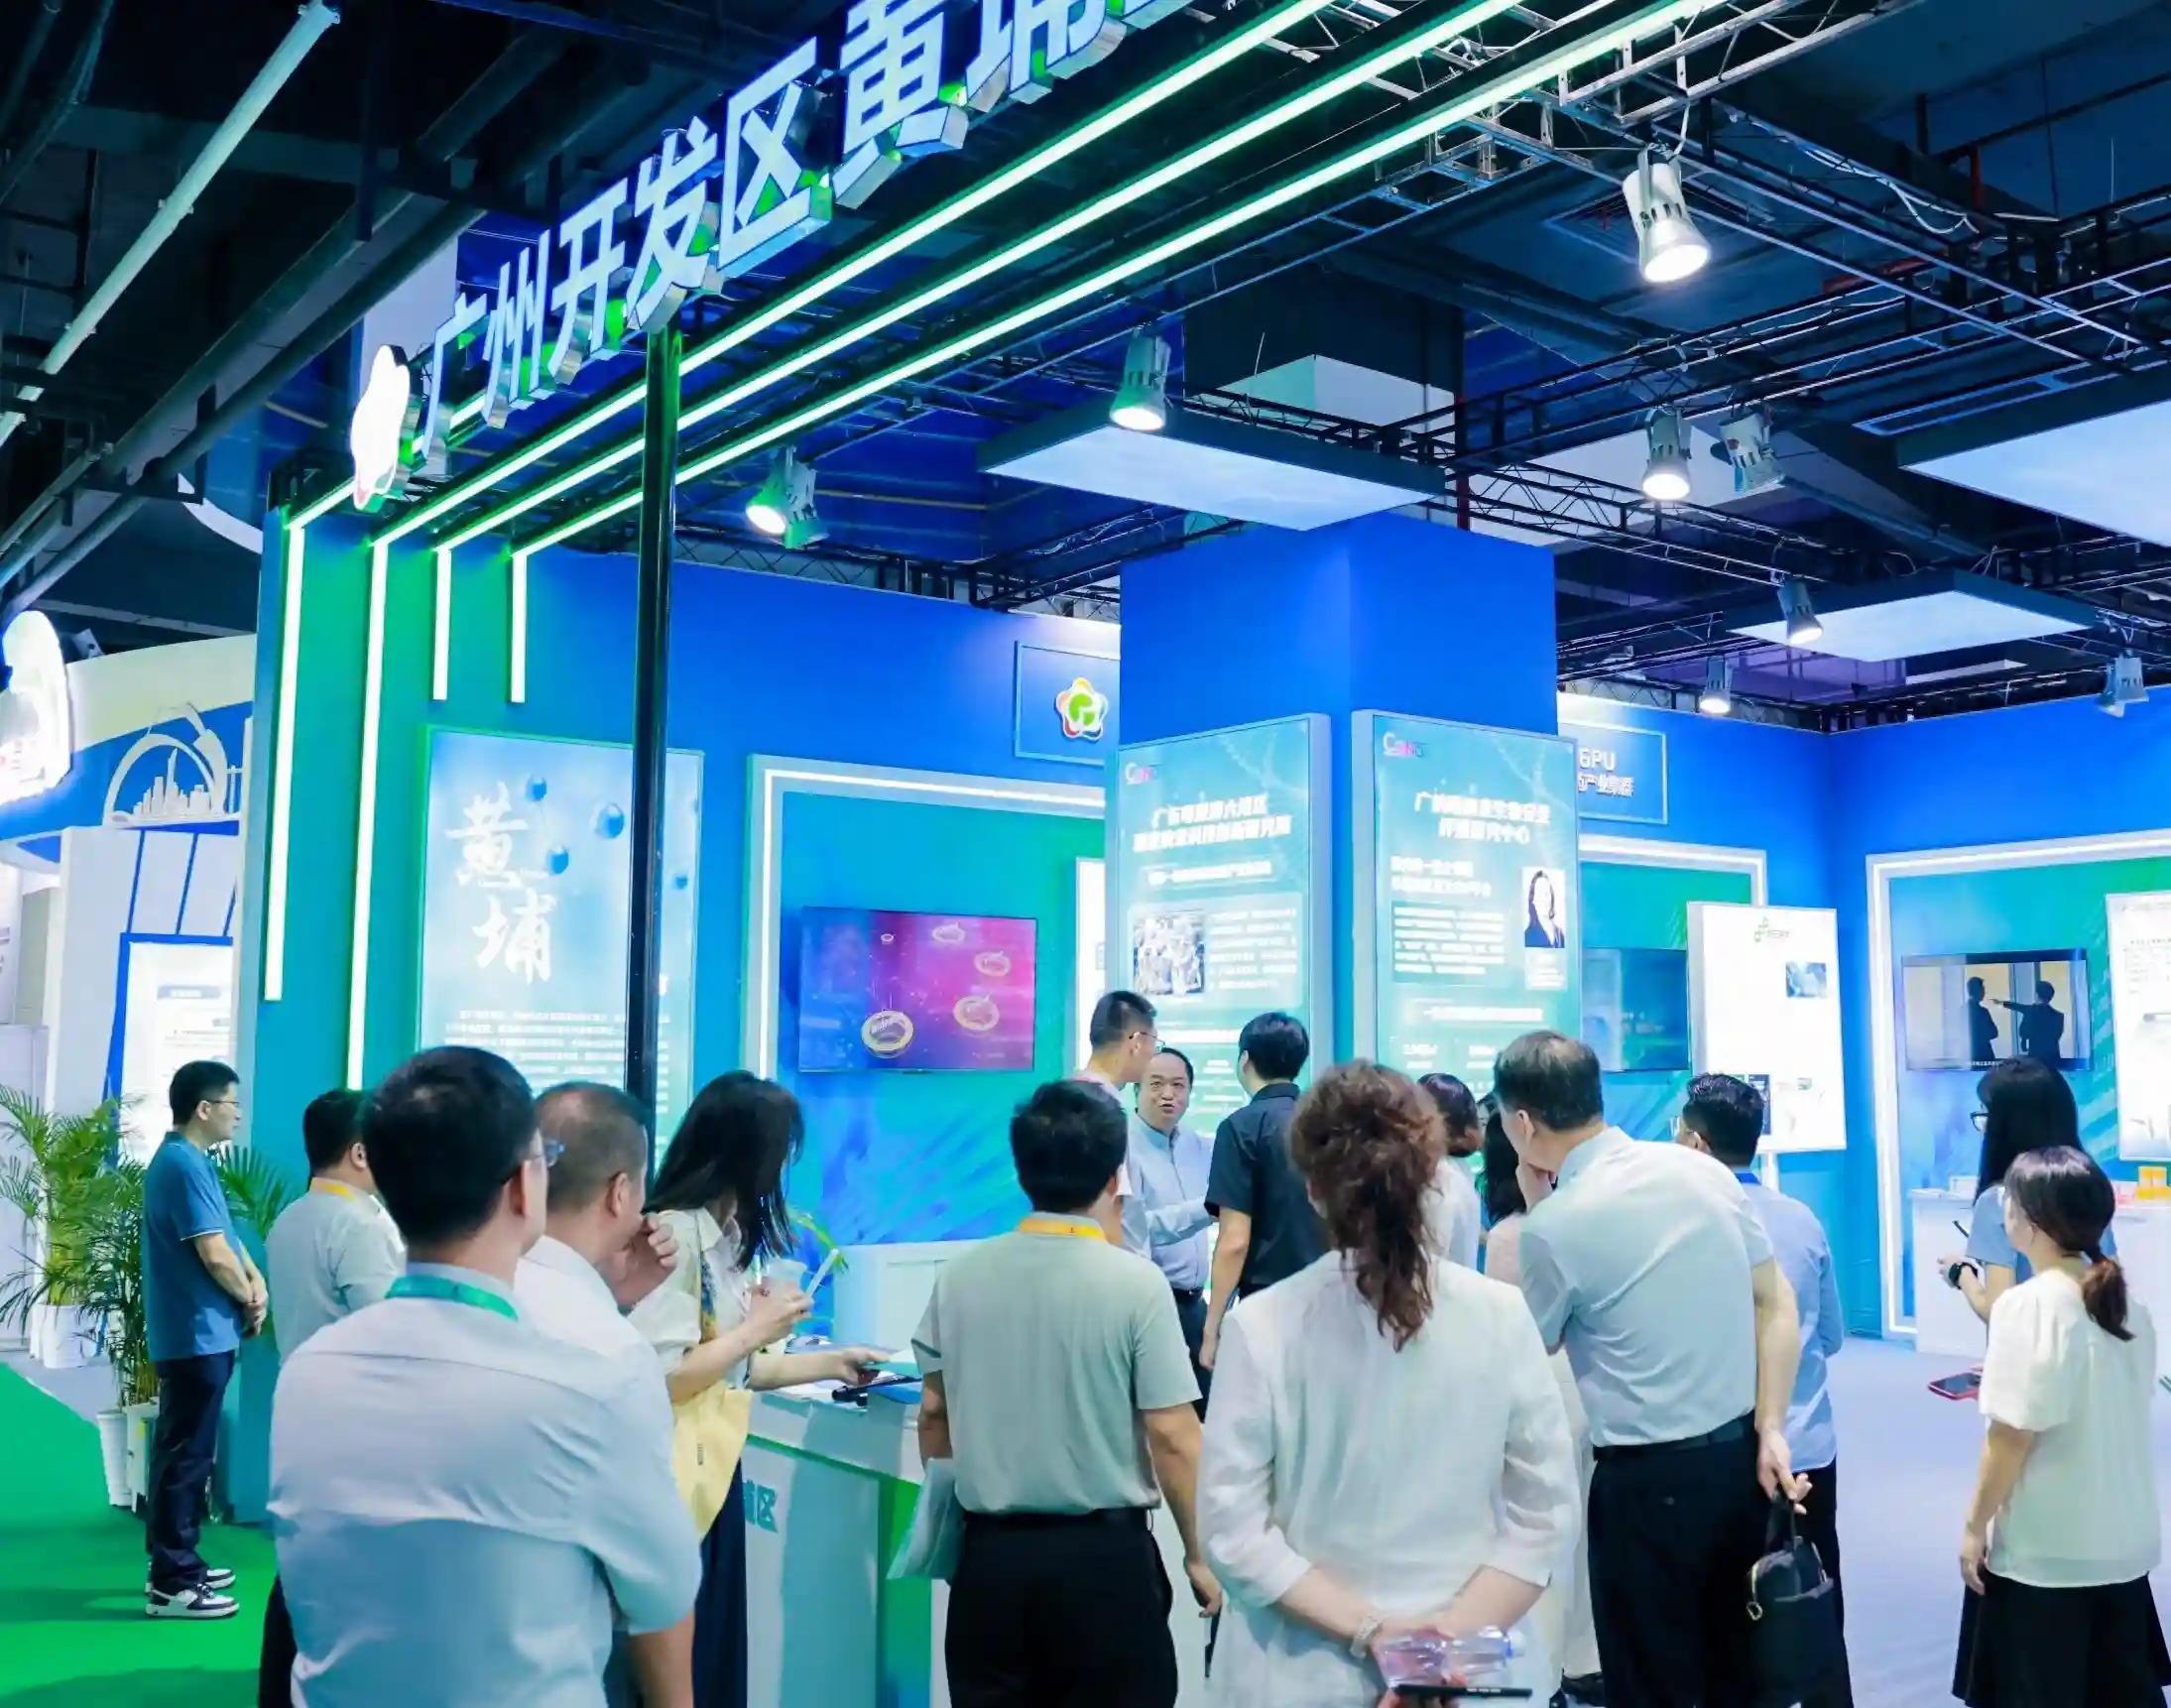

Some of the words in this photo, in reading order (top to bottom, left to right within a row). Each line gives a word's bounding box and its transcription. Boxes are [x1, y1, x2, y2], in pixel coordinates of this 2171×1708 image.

[421, 0, 1162, 461] 广州开发区黄埔
